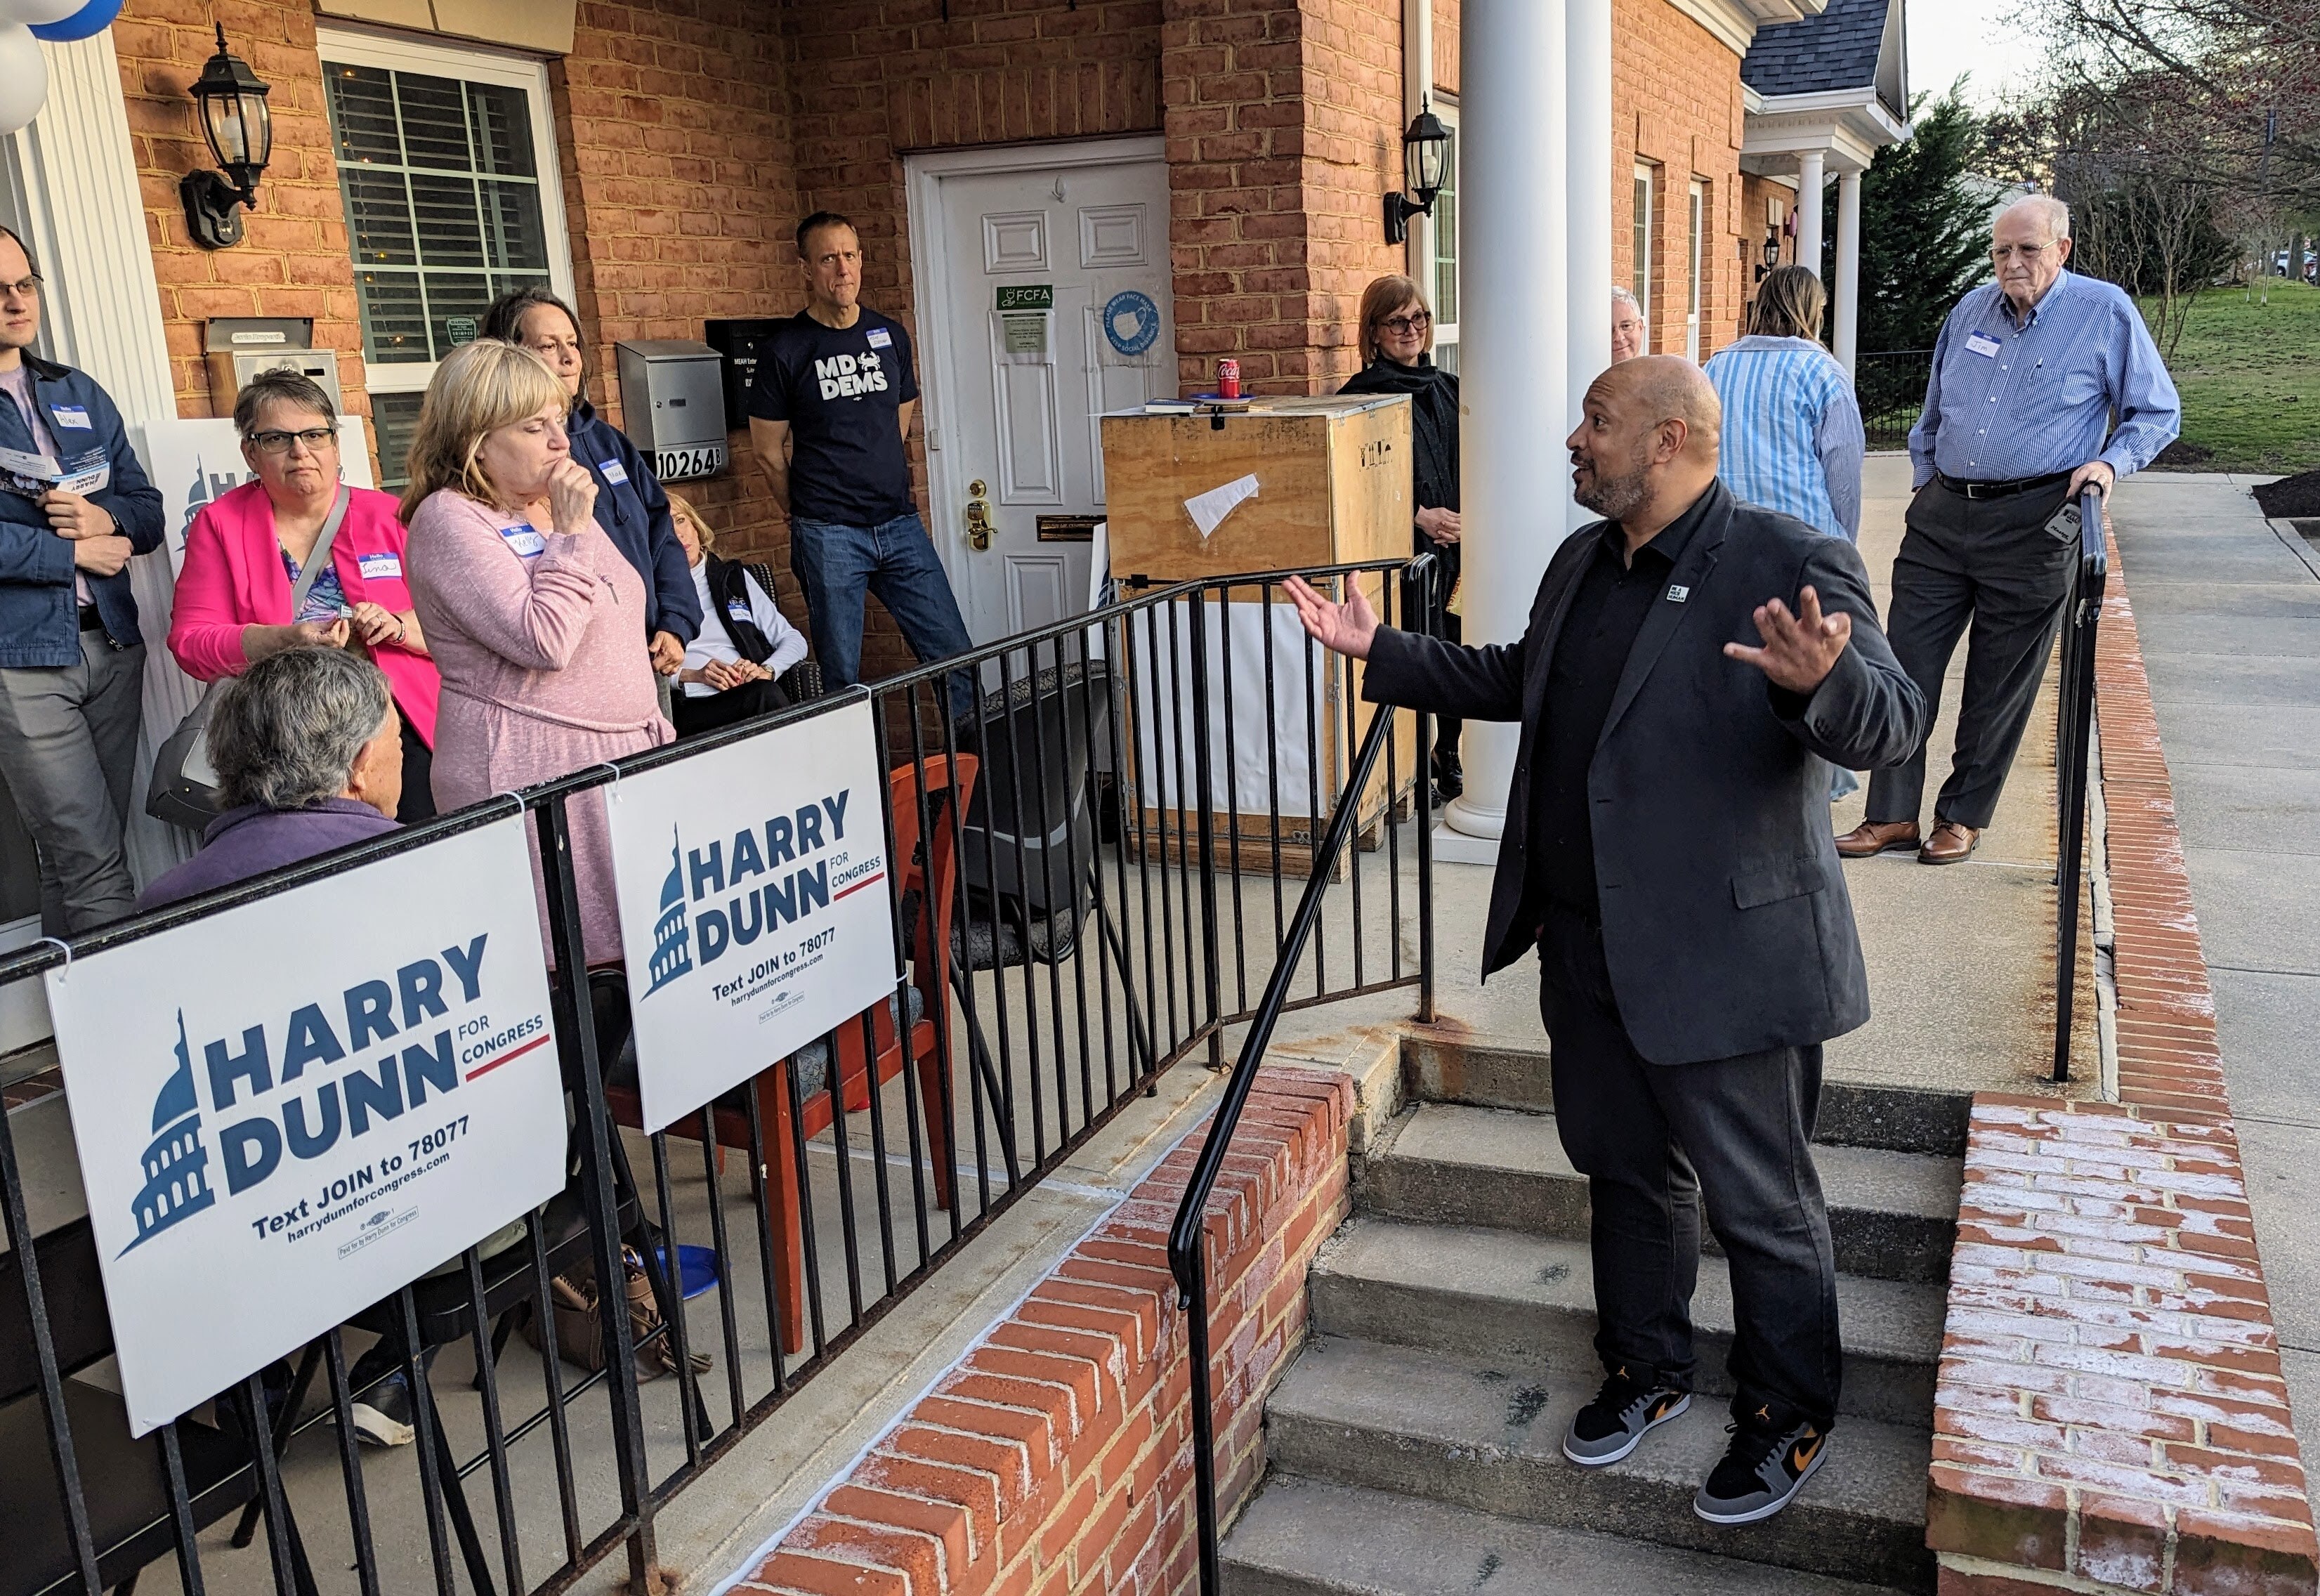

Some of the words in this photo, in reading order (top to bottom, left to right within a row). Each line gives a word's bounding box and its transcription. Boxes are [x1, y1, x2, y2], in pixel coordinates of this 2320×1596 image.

[1016, 289, 1050, 301] FCFA
[1111, 295, 1125, 307] WEAR
[1139, 298, 1153, 313] MASK
[1110, 336, 1122, 348] KEEP
[1972, 341, 1988, 351] Jim
[815, 354, 857, 380] MD
[819, 371, 888, 400] DEMS
[58, 413, 79, 426] Alex
[658, 449, 715, 478] 10264
[716, 449, 721, 464] B
[688, 788, 850, 903] HARRY
[830, 851, 849, 870] FOR
[832, 856, 881, 888] CONGRESS
[695, 859, 830, 967] DUNN
[712, 974, 744, 1002] Text
[747, 955, 780, 984] JOIN
[783, 951, 796, 966] to
[799, 926, 835, 957] 78077
[731, 953, 824, 1007] harrydunnforcongress.com
[204, 933, 488, 1113] HARRY
[458, 1015, 490, 1040] FOR
[461, 1015, 544, 1064] CONGRESS
[219, 1028, 459, 1197] DUNN
[252, 1198, 310, 1241] Text
[316, 1164, 374, 1210] JOIN
[380, 1156, 402, 1177] to
[407, 1114, 469, 1161] 78077
[287, 1152, 450, 1243] harrydunnforcongress.com
[339, 1246, 350, 1256] Paid
[365, 1232, 377, 1241] Harry
[378, 1225, 390, 1236] Dunn
[397, 1210, 417, 1224] Congress
